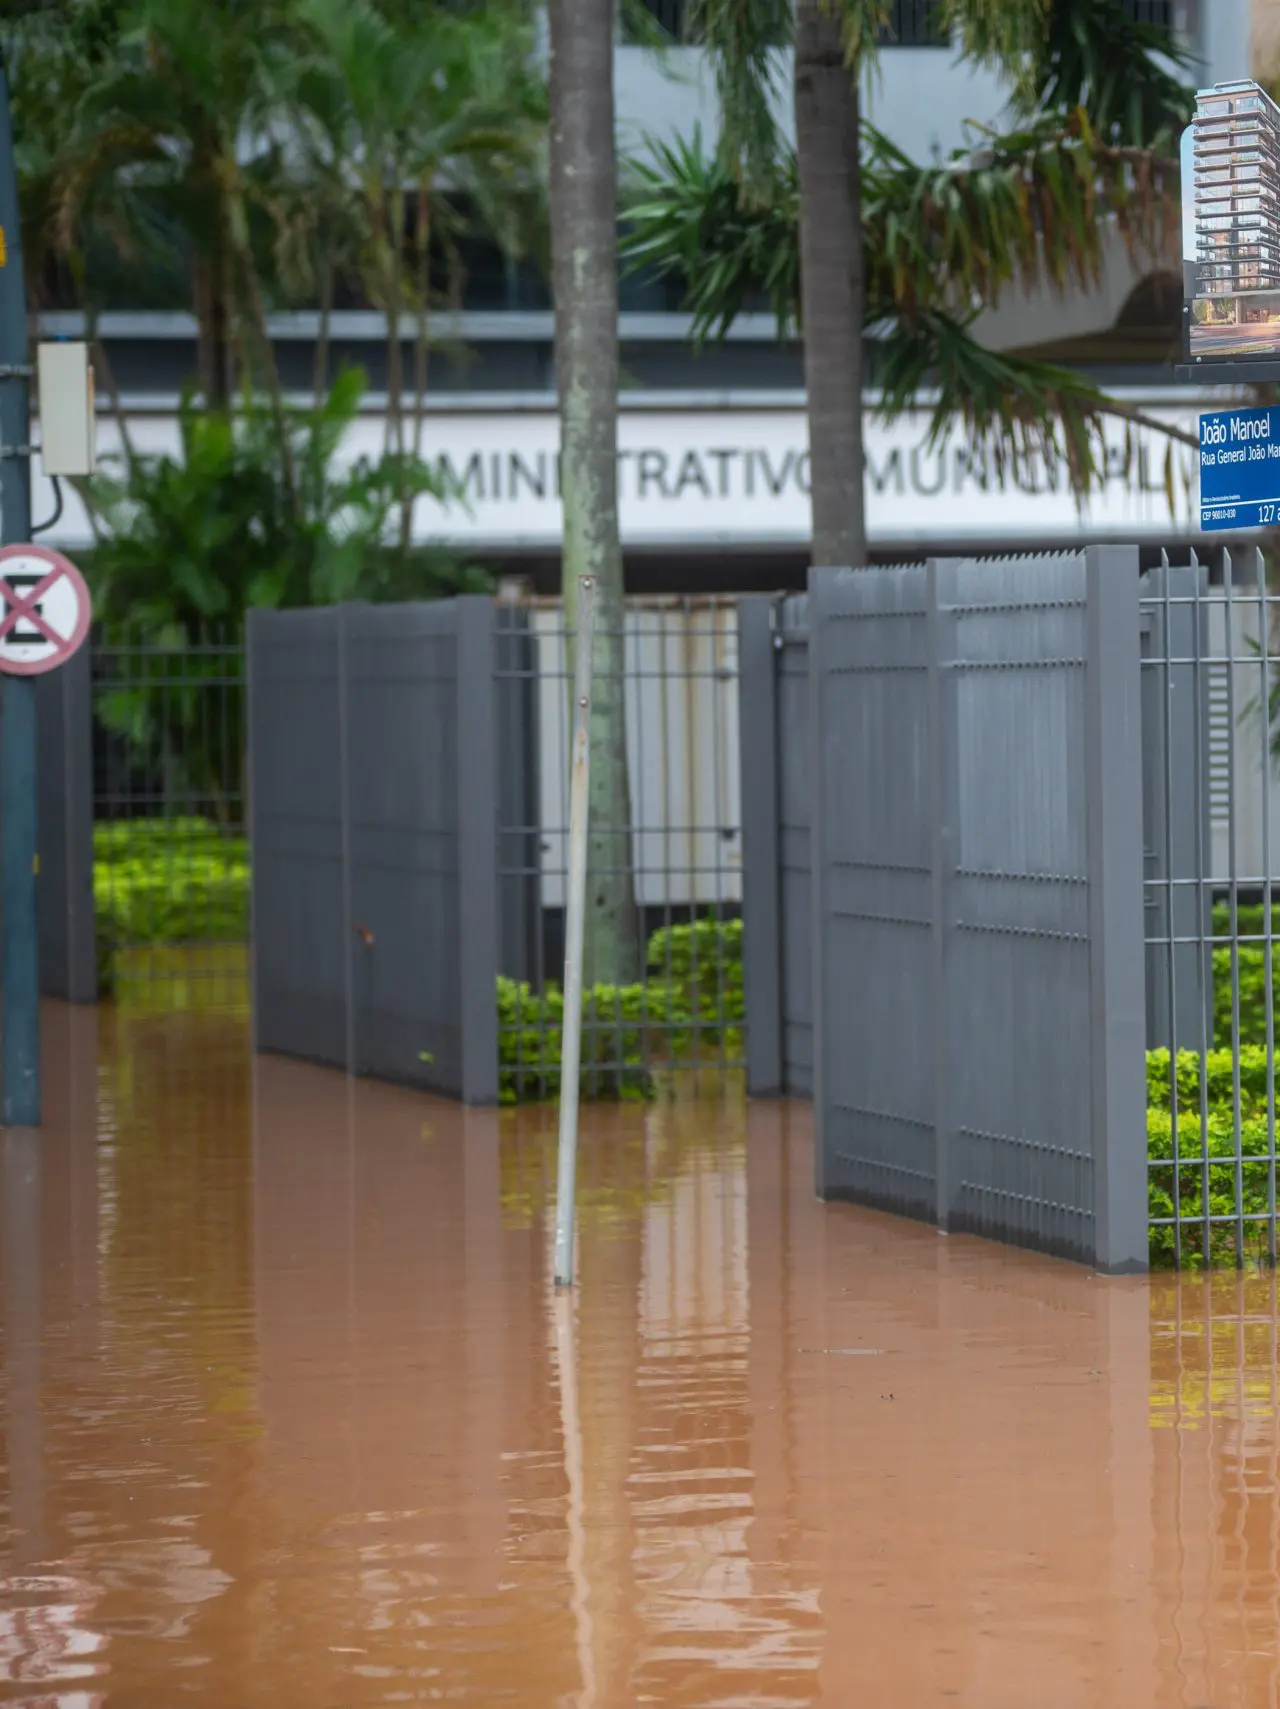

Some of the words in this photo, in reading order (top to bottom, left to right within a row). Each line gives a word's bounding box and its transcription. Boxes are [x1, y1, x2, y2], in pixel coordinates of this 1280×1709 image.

[1201, 418, 1227, 445] João
[1230, 412, 1270, 441] Manoel
[1201, 451, 1216, 466] Rua
[1217, 446, 1246, 464] General
[1248, 444, 1265, 461] João
[1202, 511, 1212, 521] CEP
[1258, 504, 1275, 523] 127
